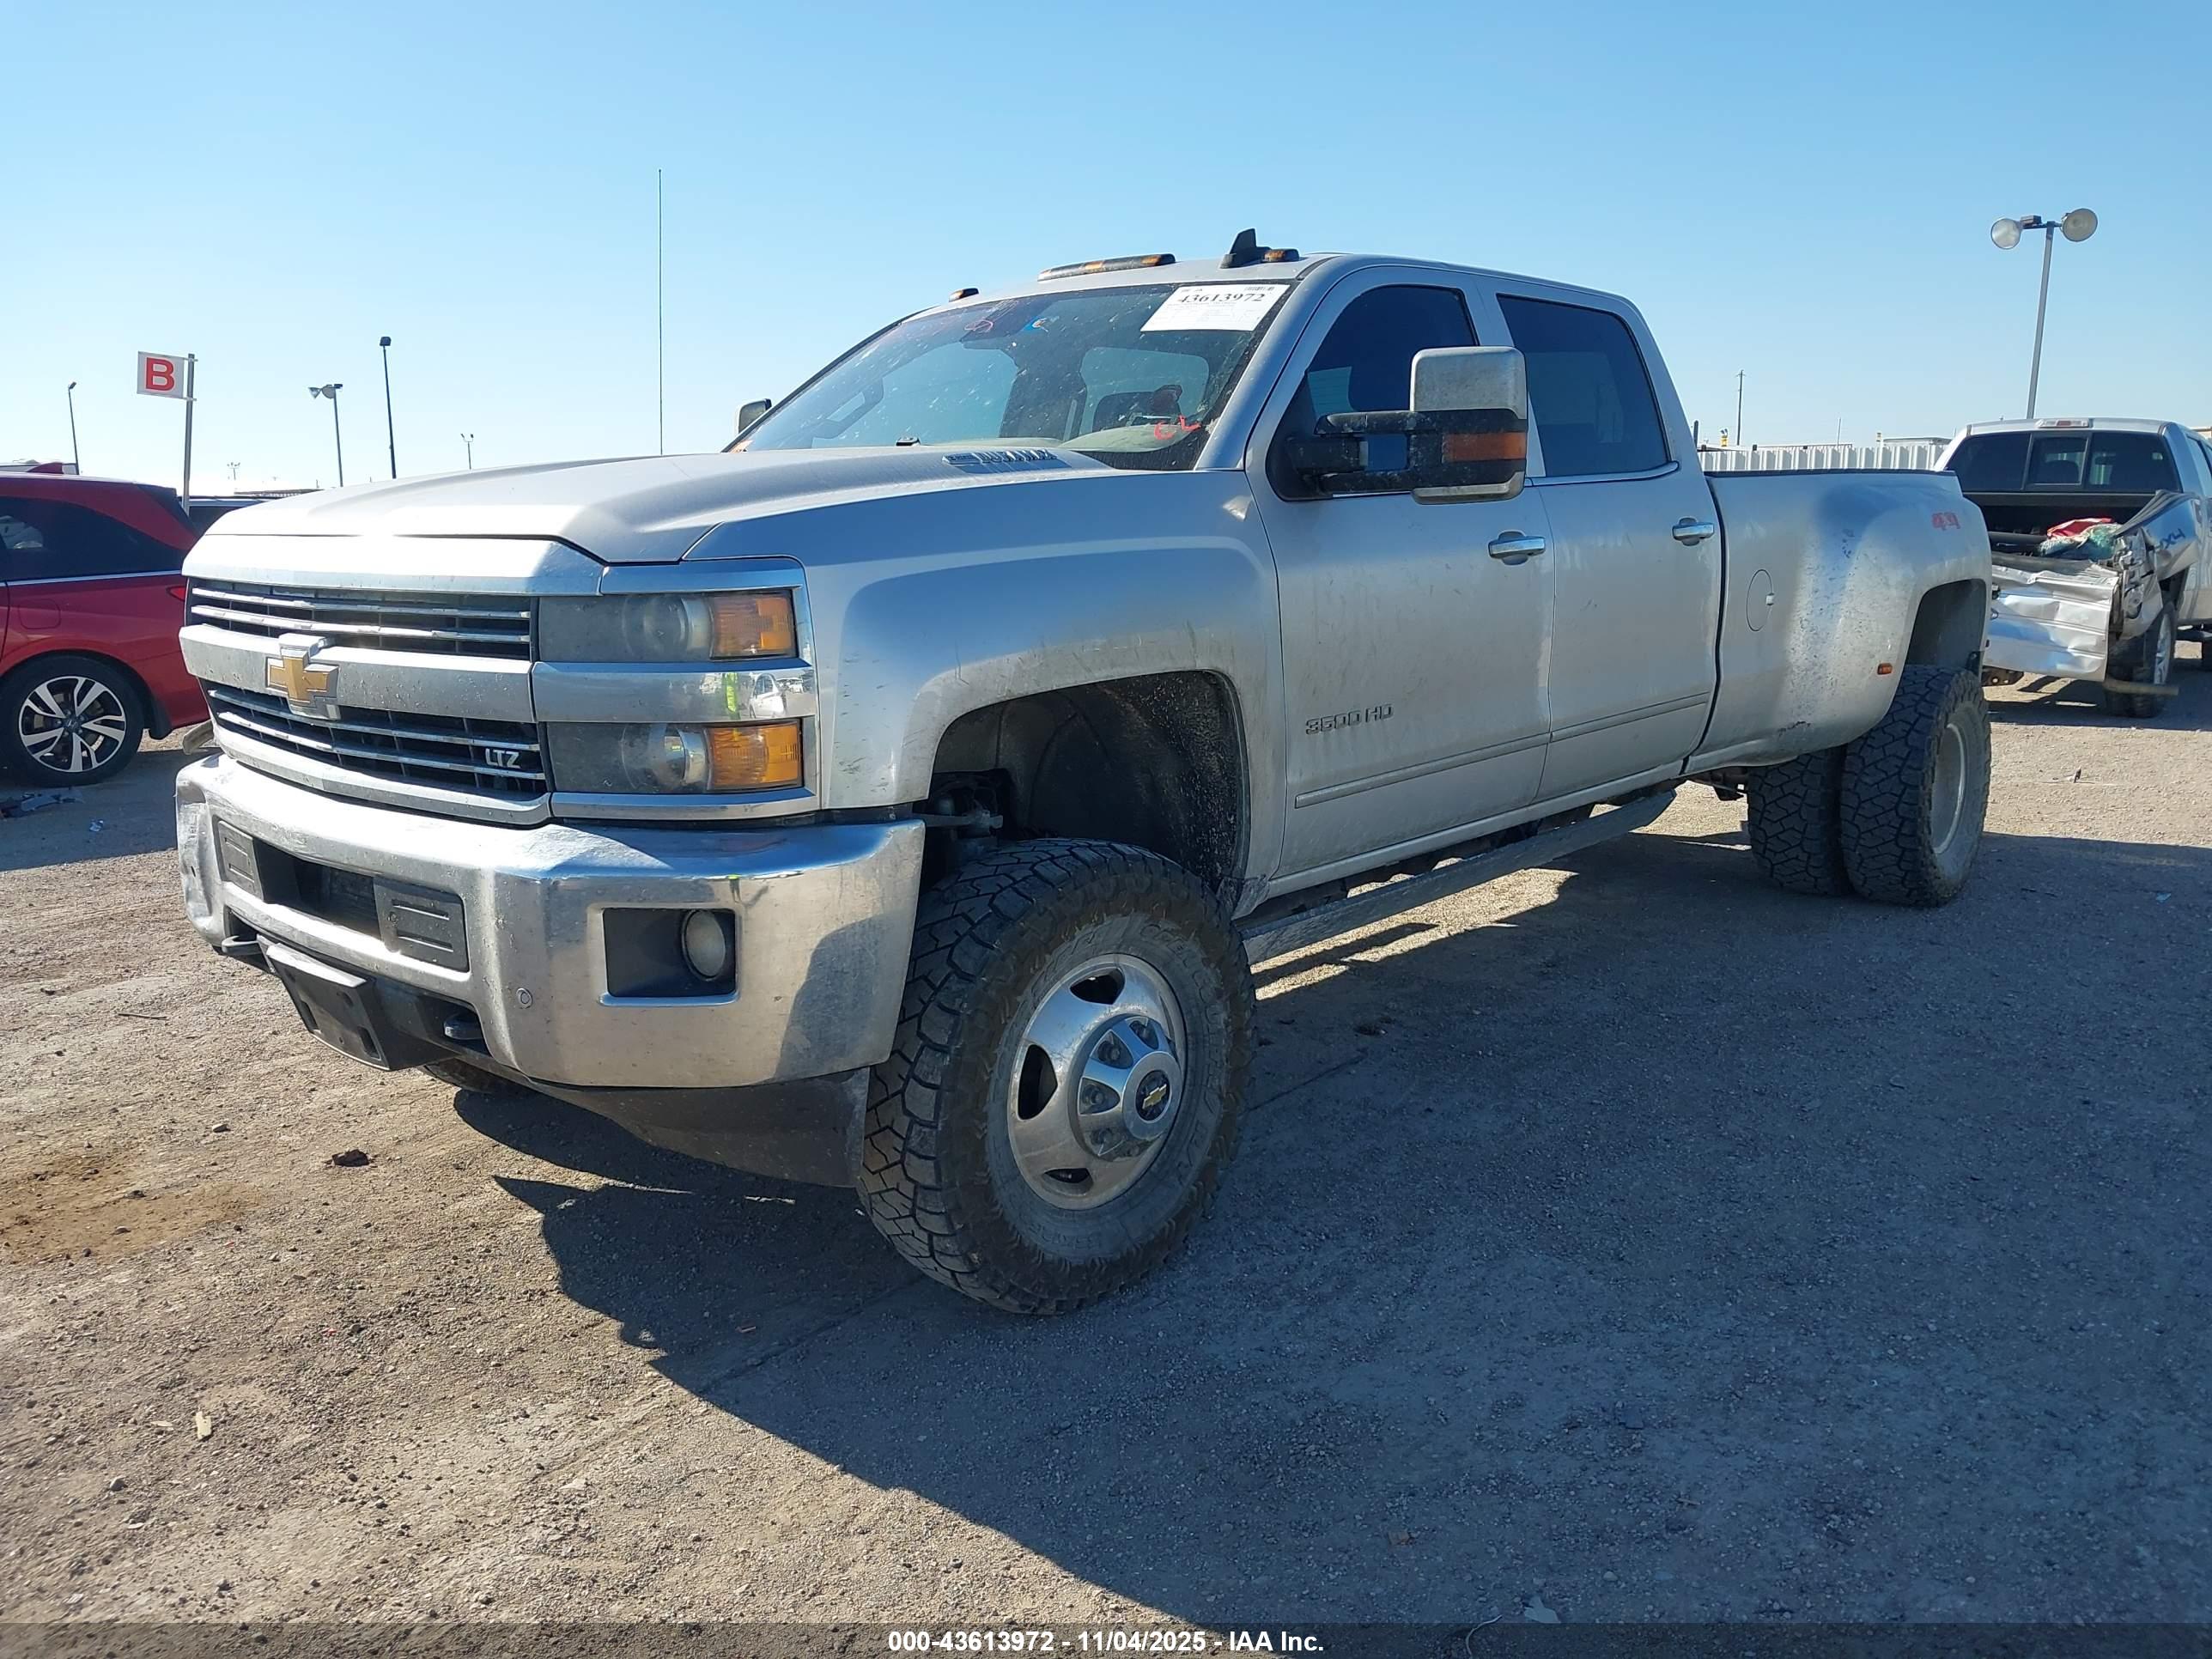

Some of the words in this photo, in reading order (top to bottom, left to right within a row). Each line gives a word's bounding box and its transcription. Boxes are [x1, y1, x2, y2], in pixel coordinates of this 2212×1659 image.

[1177, 293, 1266, 303] 43613972
[146, 356, 175, 392] B
[1305, 710, 1361, 735] 3500
[1365, 703, 1394, 723] HD
[485, 748, 521, 769] LTZ
